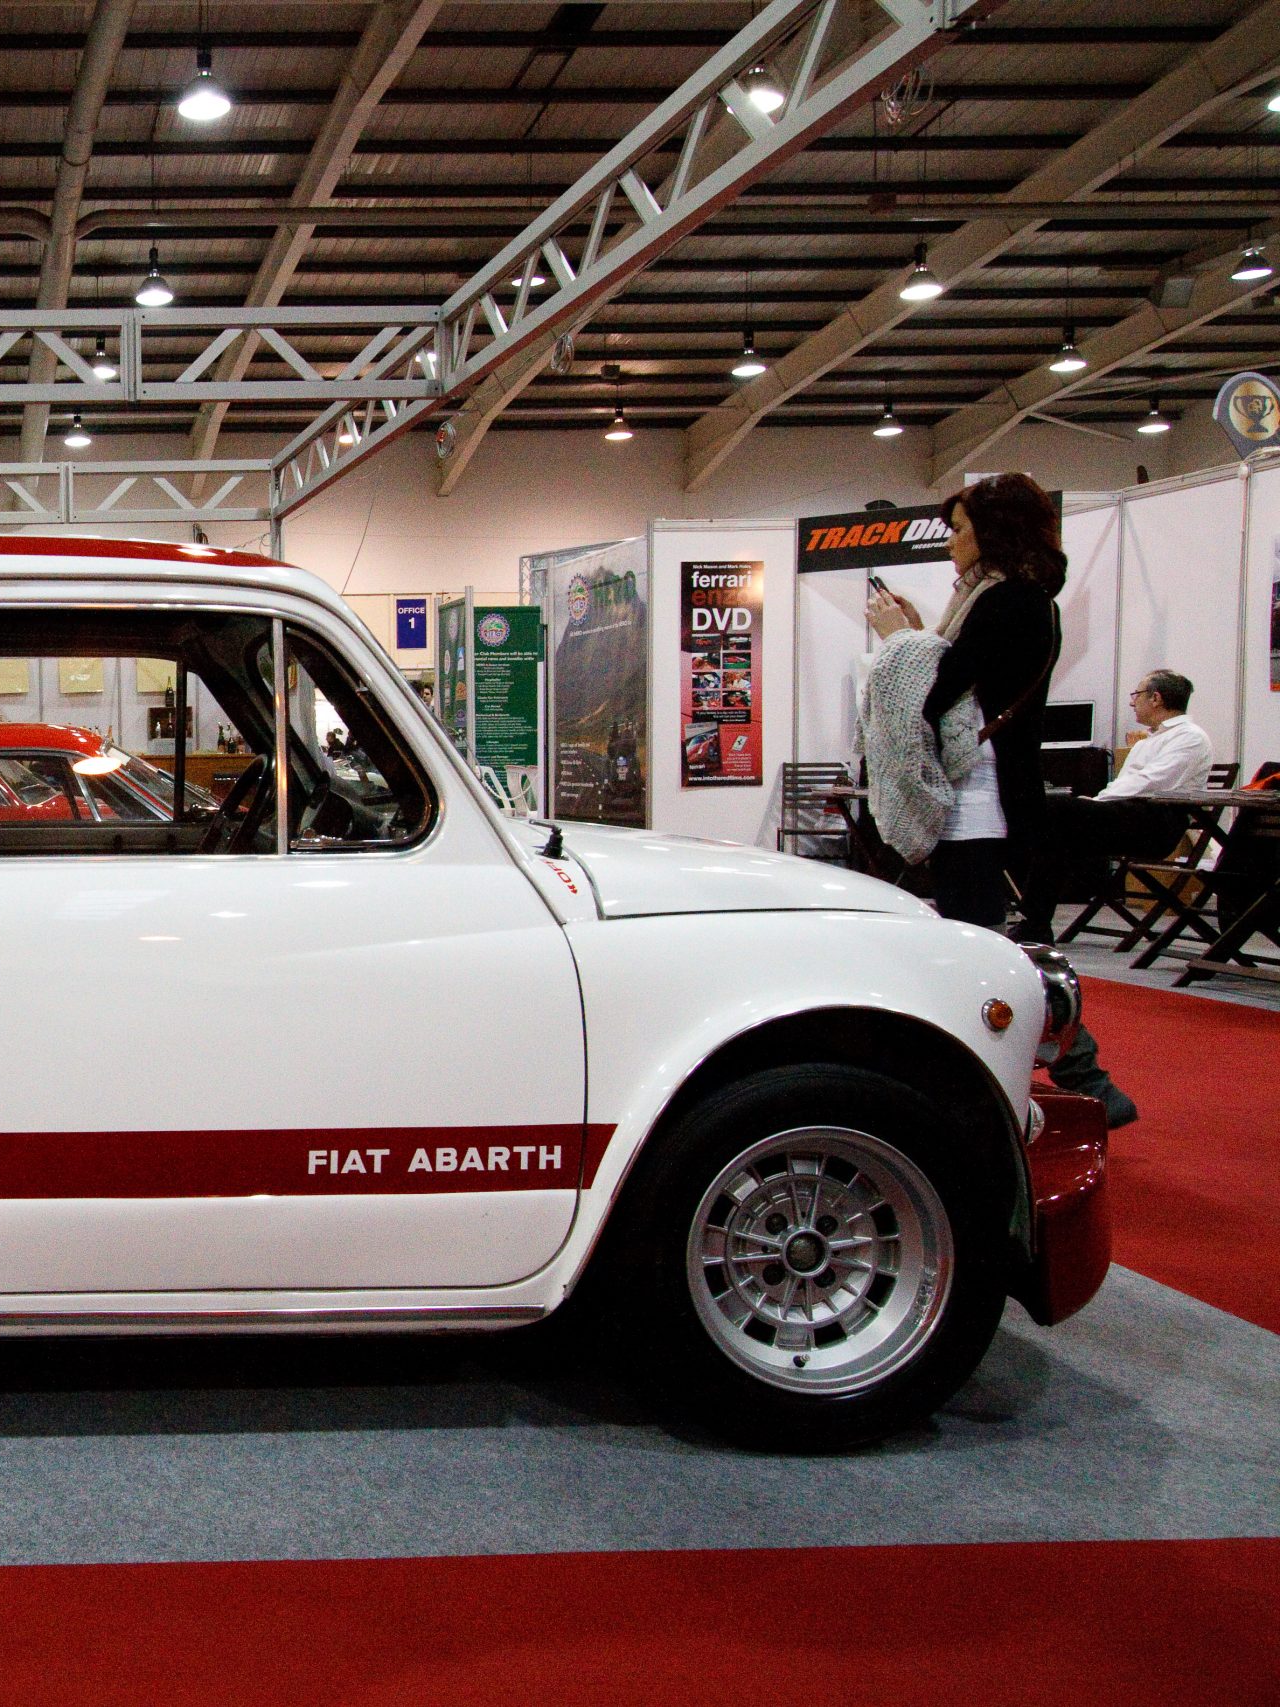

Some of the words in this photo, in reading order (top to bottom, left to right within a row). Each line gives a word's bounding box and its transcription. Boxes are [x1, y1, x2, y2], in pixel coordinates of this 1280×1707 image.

[691, 570, 752, 588] ferrari
[408, 617, 415, 629] 1
[691, 607, 752, 631] DVD
[308, 1149, 390, 1175] FIAT
[408, 1145, 562, 1173] ABARTH
